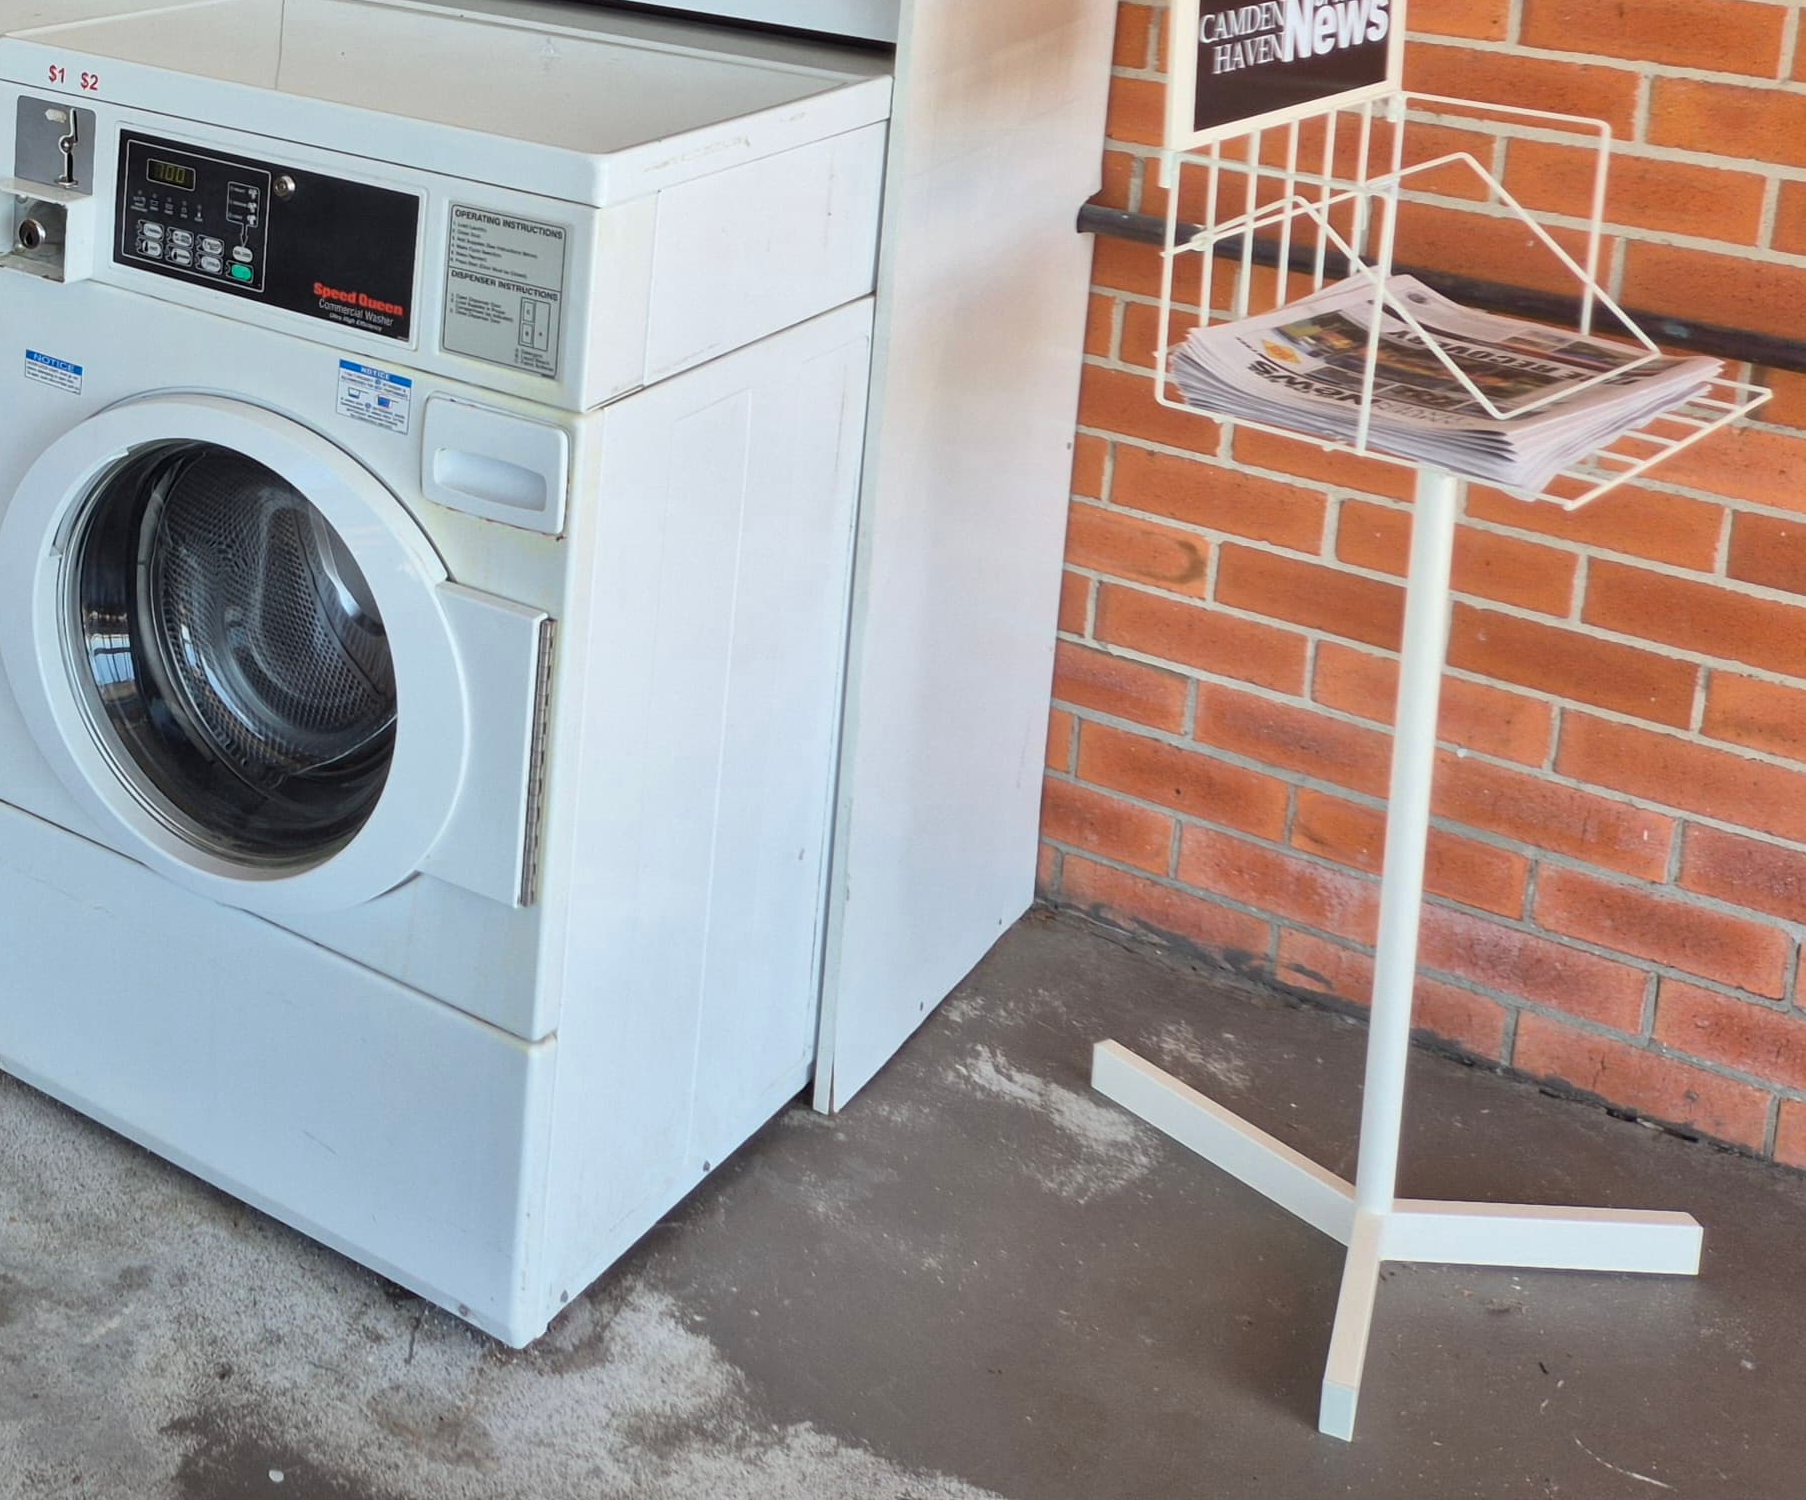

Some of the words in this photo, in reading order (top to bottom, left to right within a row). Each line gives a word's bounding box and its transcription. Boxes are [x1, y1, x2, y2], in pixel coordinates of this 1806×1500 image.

[1199, 0, 1287, 44] CAMDEN
[1212, 32, 1285, 74] HAVEN
[49, 64, 64, 84] $1
[81, 72, 98, 90] $2
[455, 208, 501, 227] OPERATING
[502, 218, 563, 240] INSTRUCTIONS
[313, 281, 357, 304] Speed
[358, 292, 404, 316] Queen
[451, 269, 496, 287] DISPENSER
[497, 281, 558, 302] INSTRUCTIONS
[319, 298, 364, 318] Commercial
[34, 353, 74, 372] NOTICE
